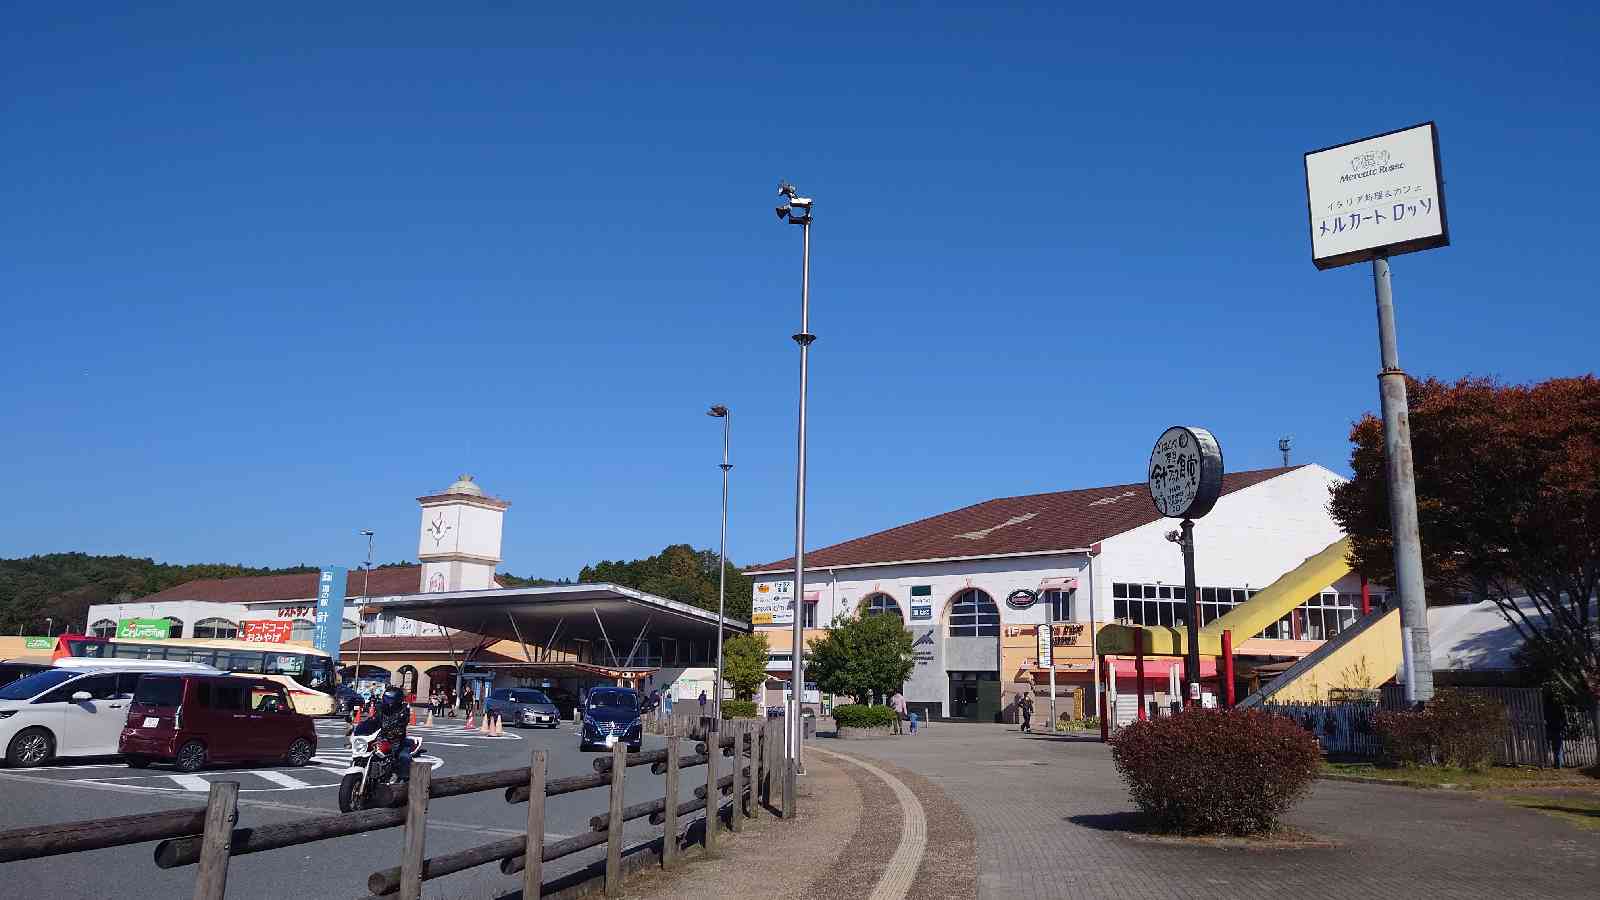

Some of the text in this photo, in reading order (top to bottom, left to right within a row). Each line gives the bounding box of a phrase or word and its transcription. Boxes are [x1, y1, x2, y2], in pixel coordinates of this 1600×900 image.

[1319, 197, 1432, 237] メルカート ロッソ
[320, 584, 330, 607] 道の駅
[248, 622, 291, 633] フードコート
[247, 632, 281, 642] おみやげ
